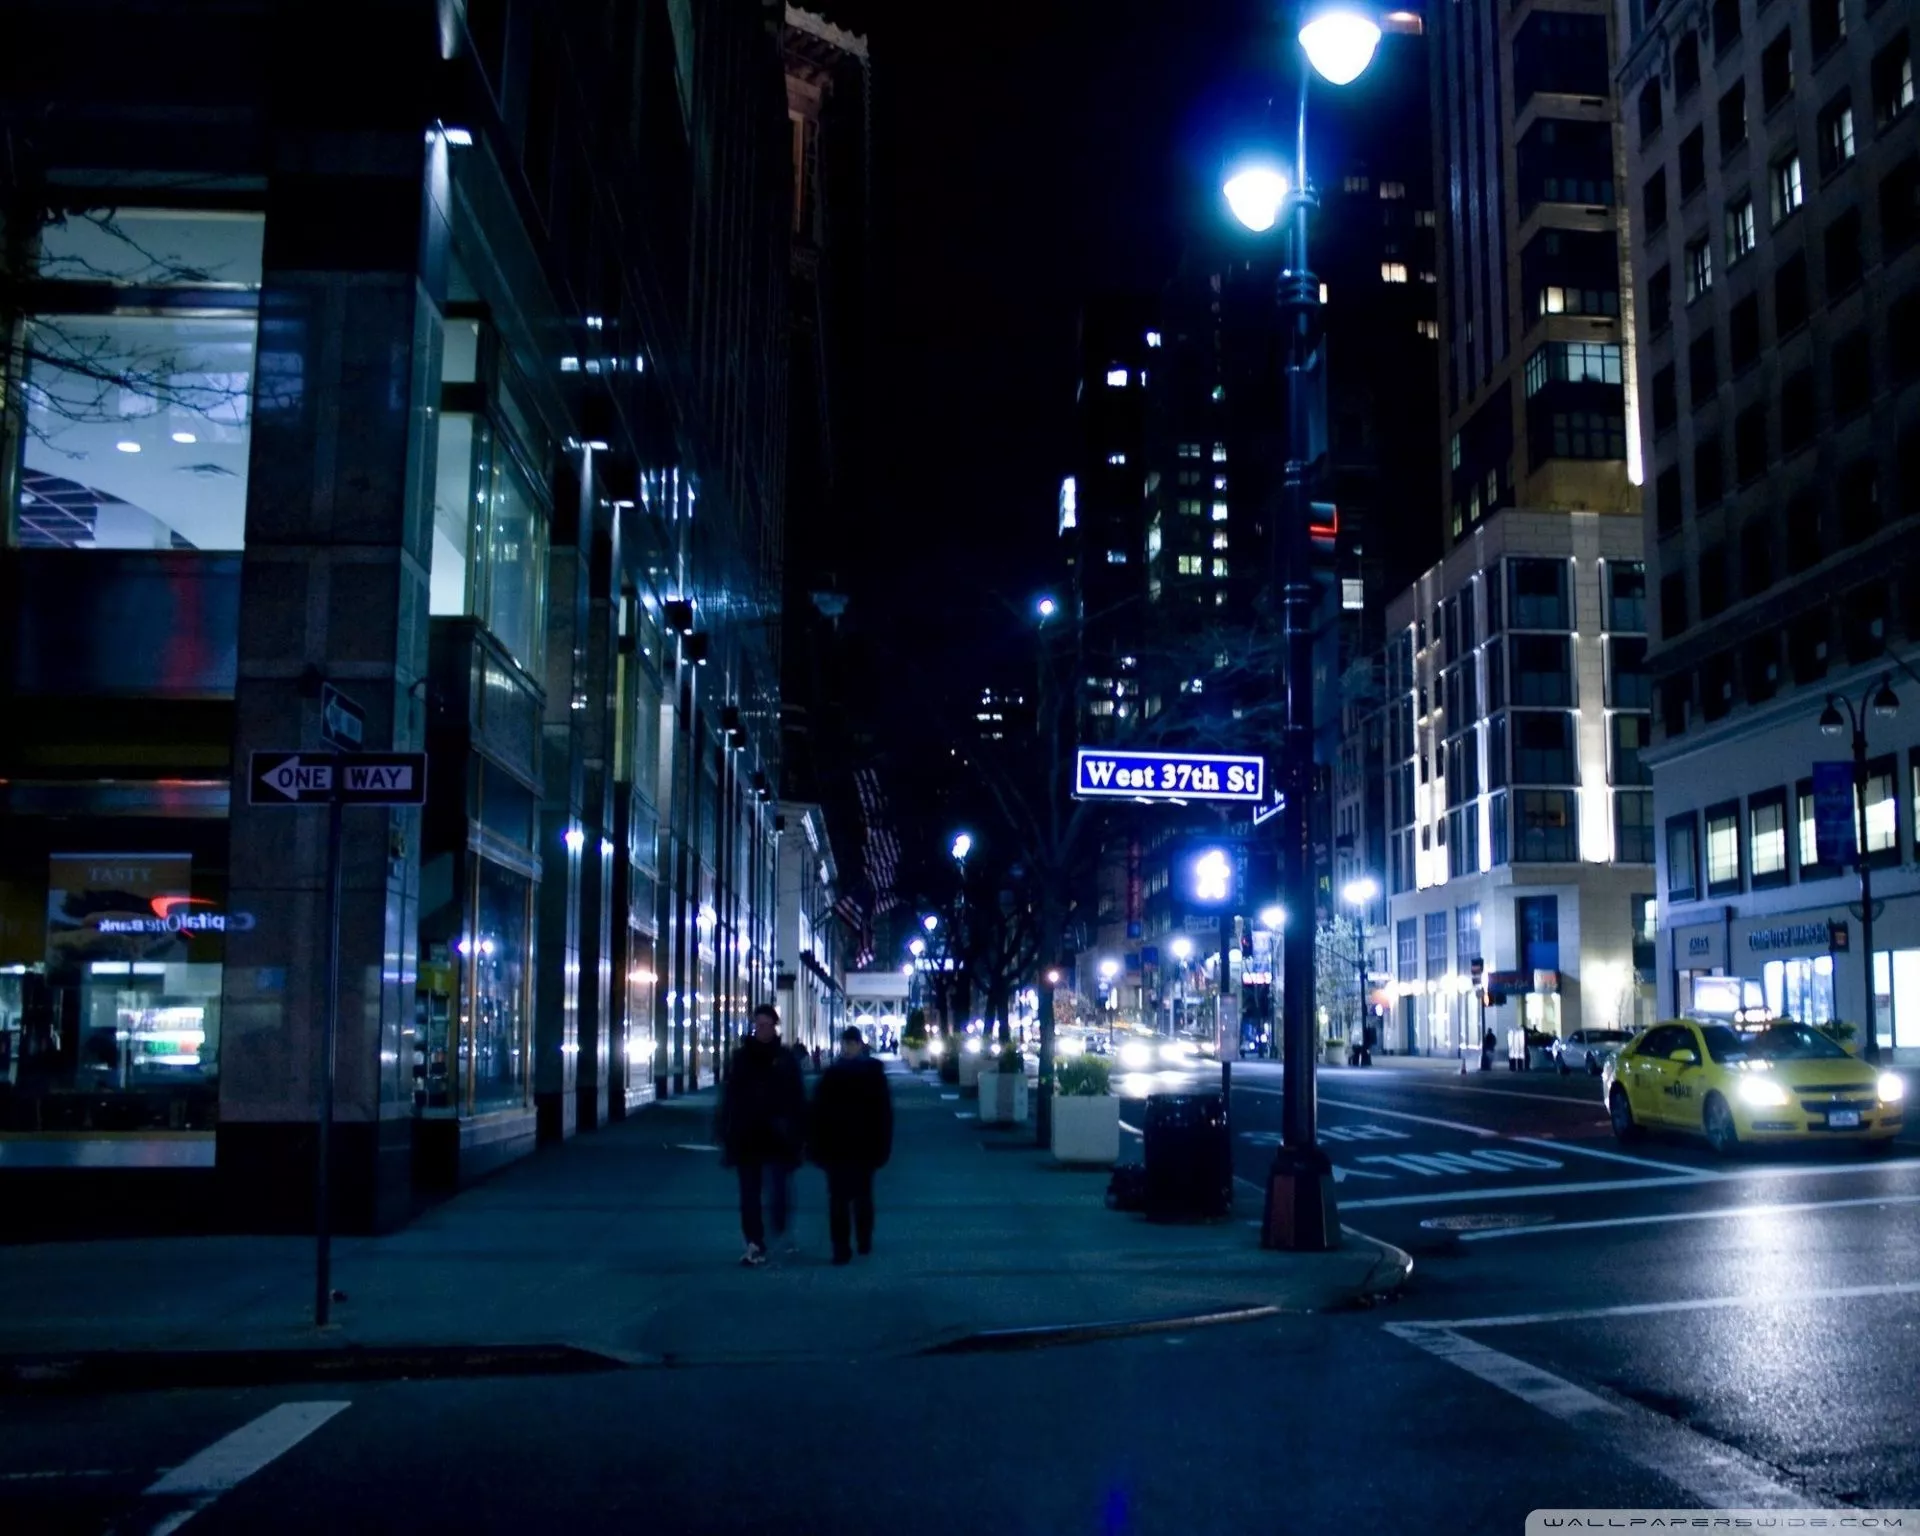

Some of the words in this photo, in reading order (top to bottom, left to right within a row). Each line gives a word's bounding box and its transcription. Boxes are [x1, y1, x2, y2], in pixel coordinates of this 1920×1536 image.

[278, 768, 326, 788] ONE
[351, 768, 401, 788] WAY
[1086, 760, 1155, 788] West
[1161, 763, 1219, 791] 37th
[1227, 765, 1255, 792] St
[88, 867, 152, 882] TASTY
